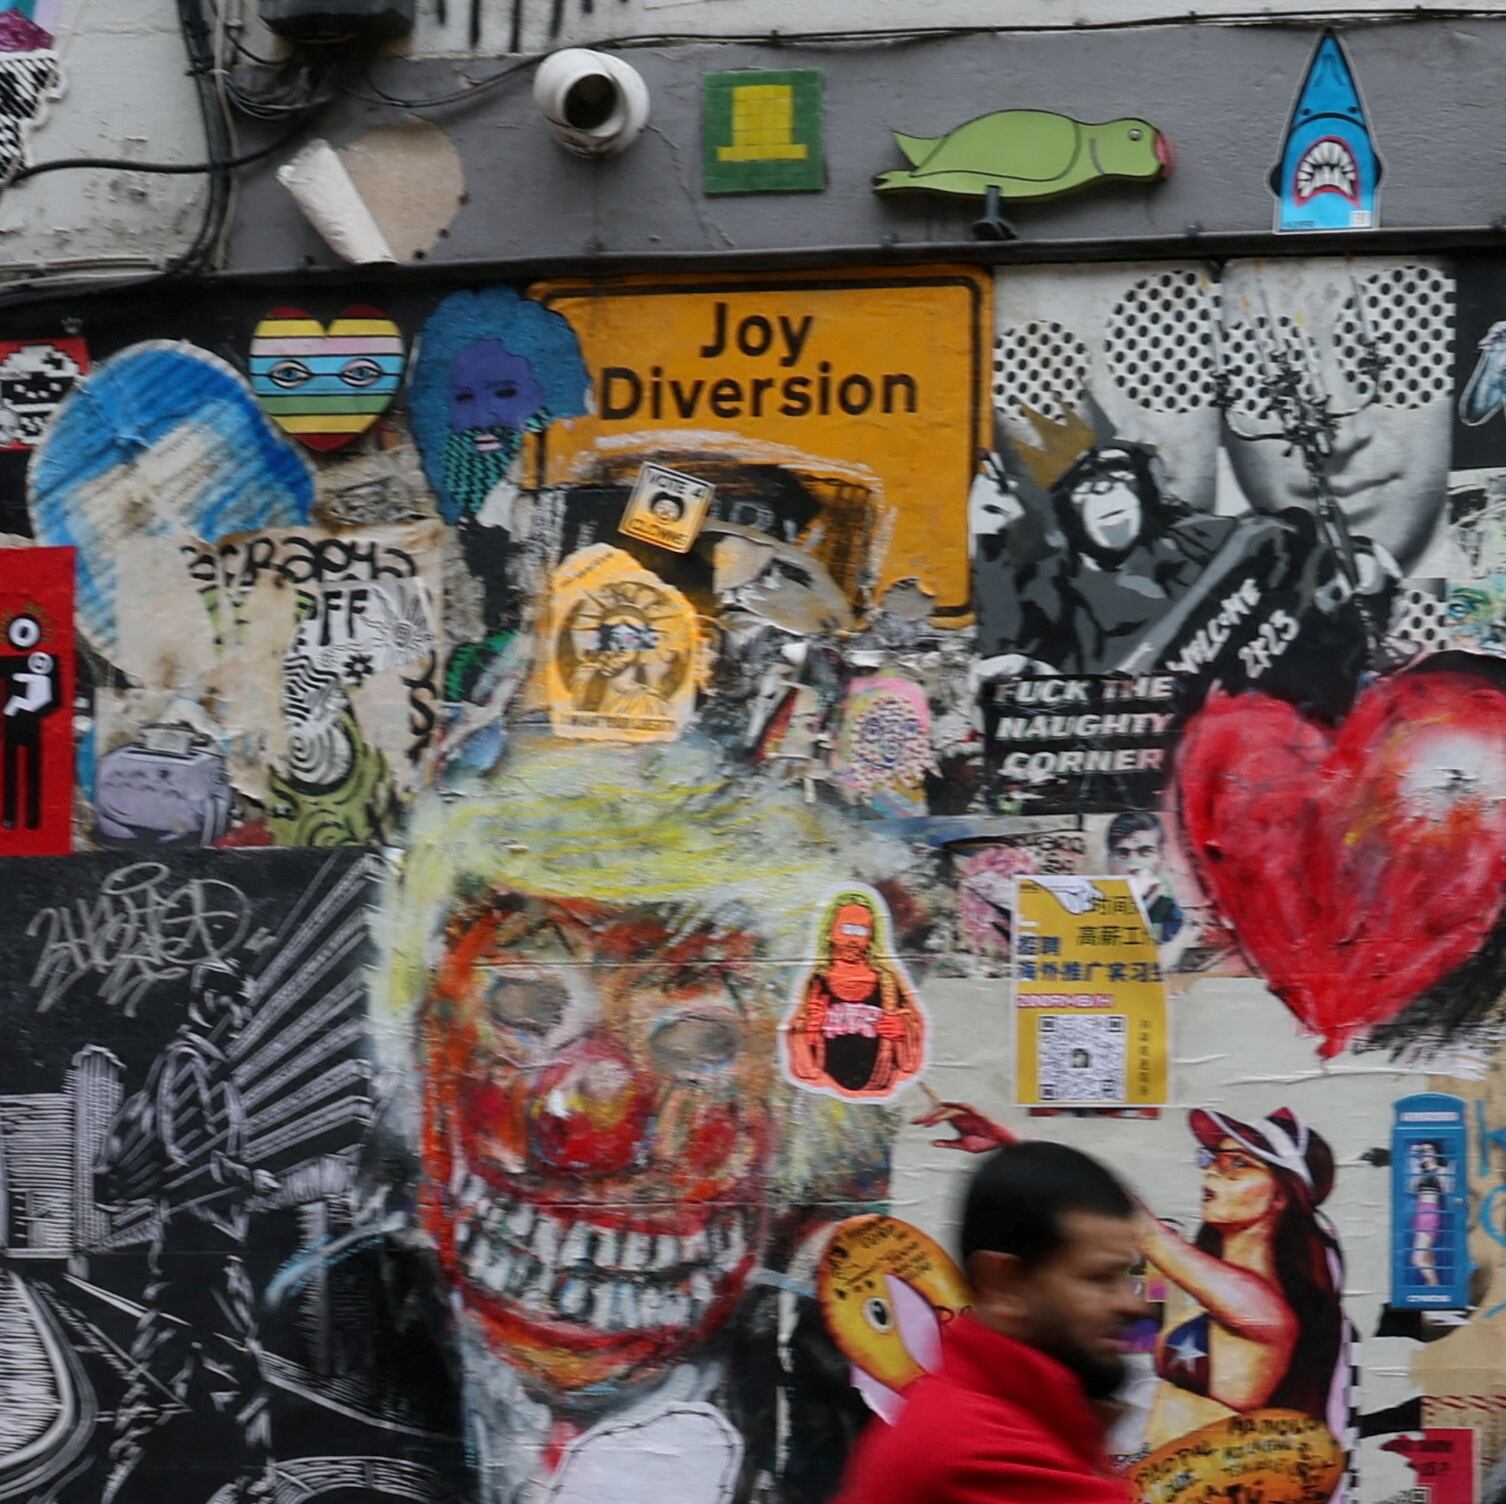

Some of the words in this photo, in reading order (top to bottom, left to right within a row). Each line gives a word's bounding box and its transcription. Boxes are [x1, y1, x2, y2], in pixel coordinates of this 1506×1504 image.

[699, 302, 814, 367] Joy
[600, 360, 917, 421] Diversion
[994, 678, 1091, 705] FUCK
[1100, 676, 1176, 700] THE
[994, 712, 1176, 741] NAUGHTY
[1002, 748, 1167, 777] CORNER
[1076, 926, 1151, 945] 高薪工
